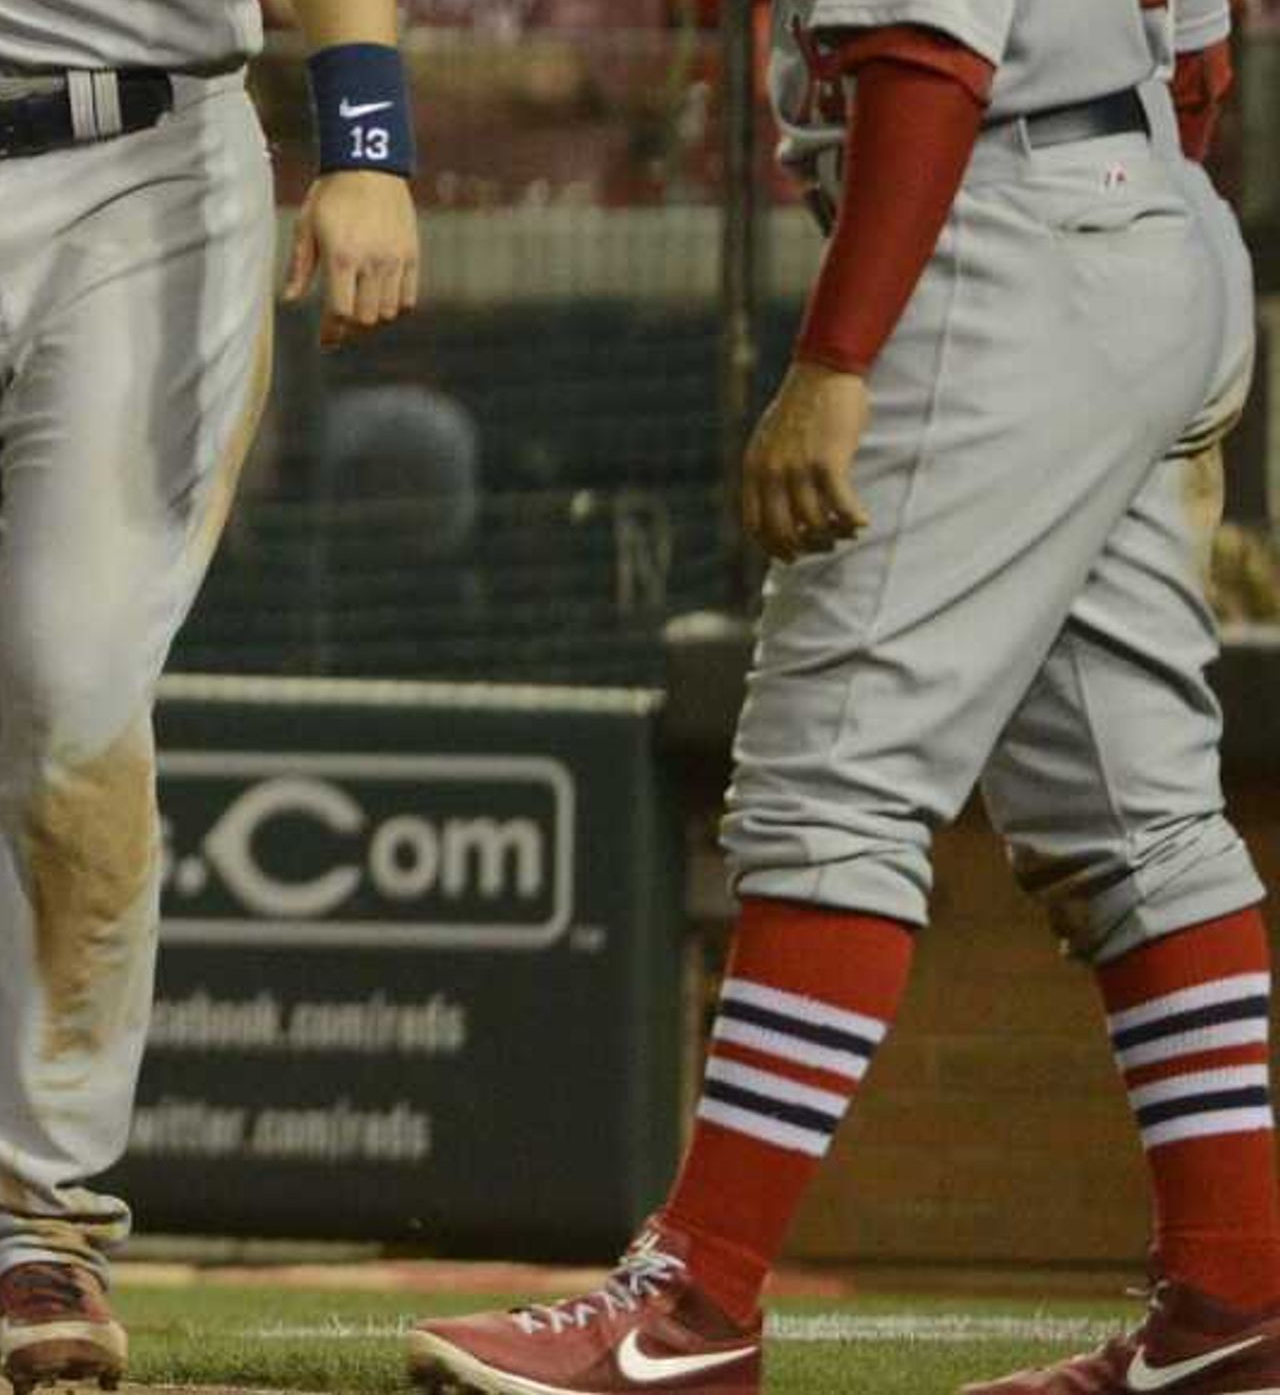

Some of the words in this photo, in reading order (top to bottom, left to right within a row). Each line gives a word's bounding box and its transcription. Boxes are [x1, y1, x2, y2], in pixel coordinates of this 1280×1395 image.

[350, 126, 389, 160] 13
[146, 988, 466, 1052] cebook.com/reds
[130, 1096, 430, 1158] witter.com/reds
